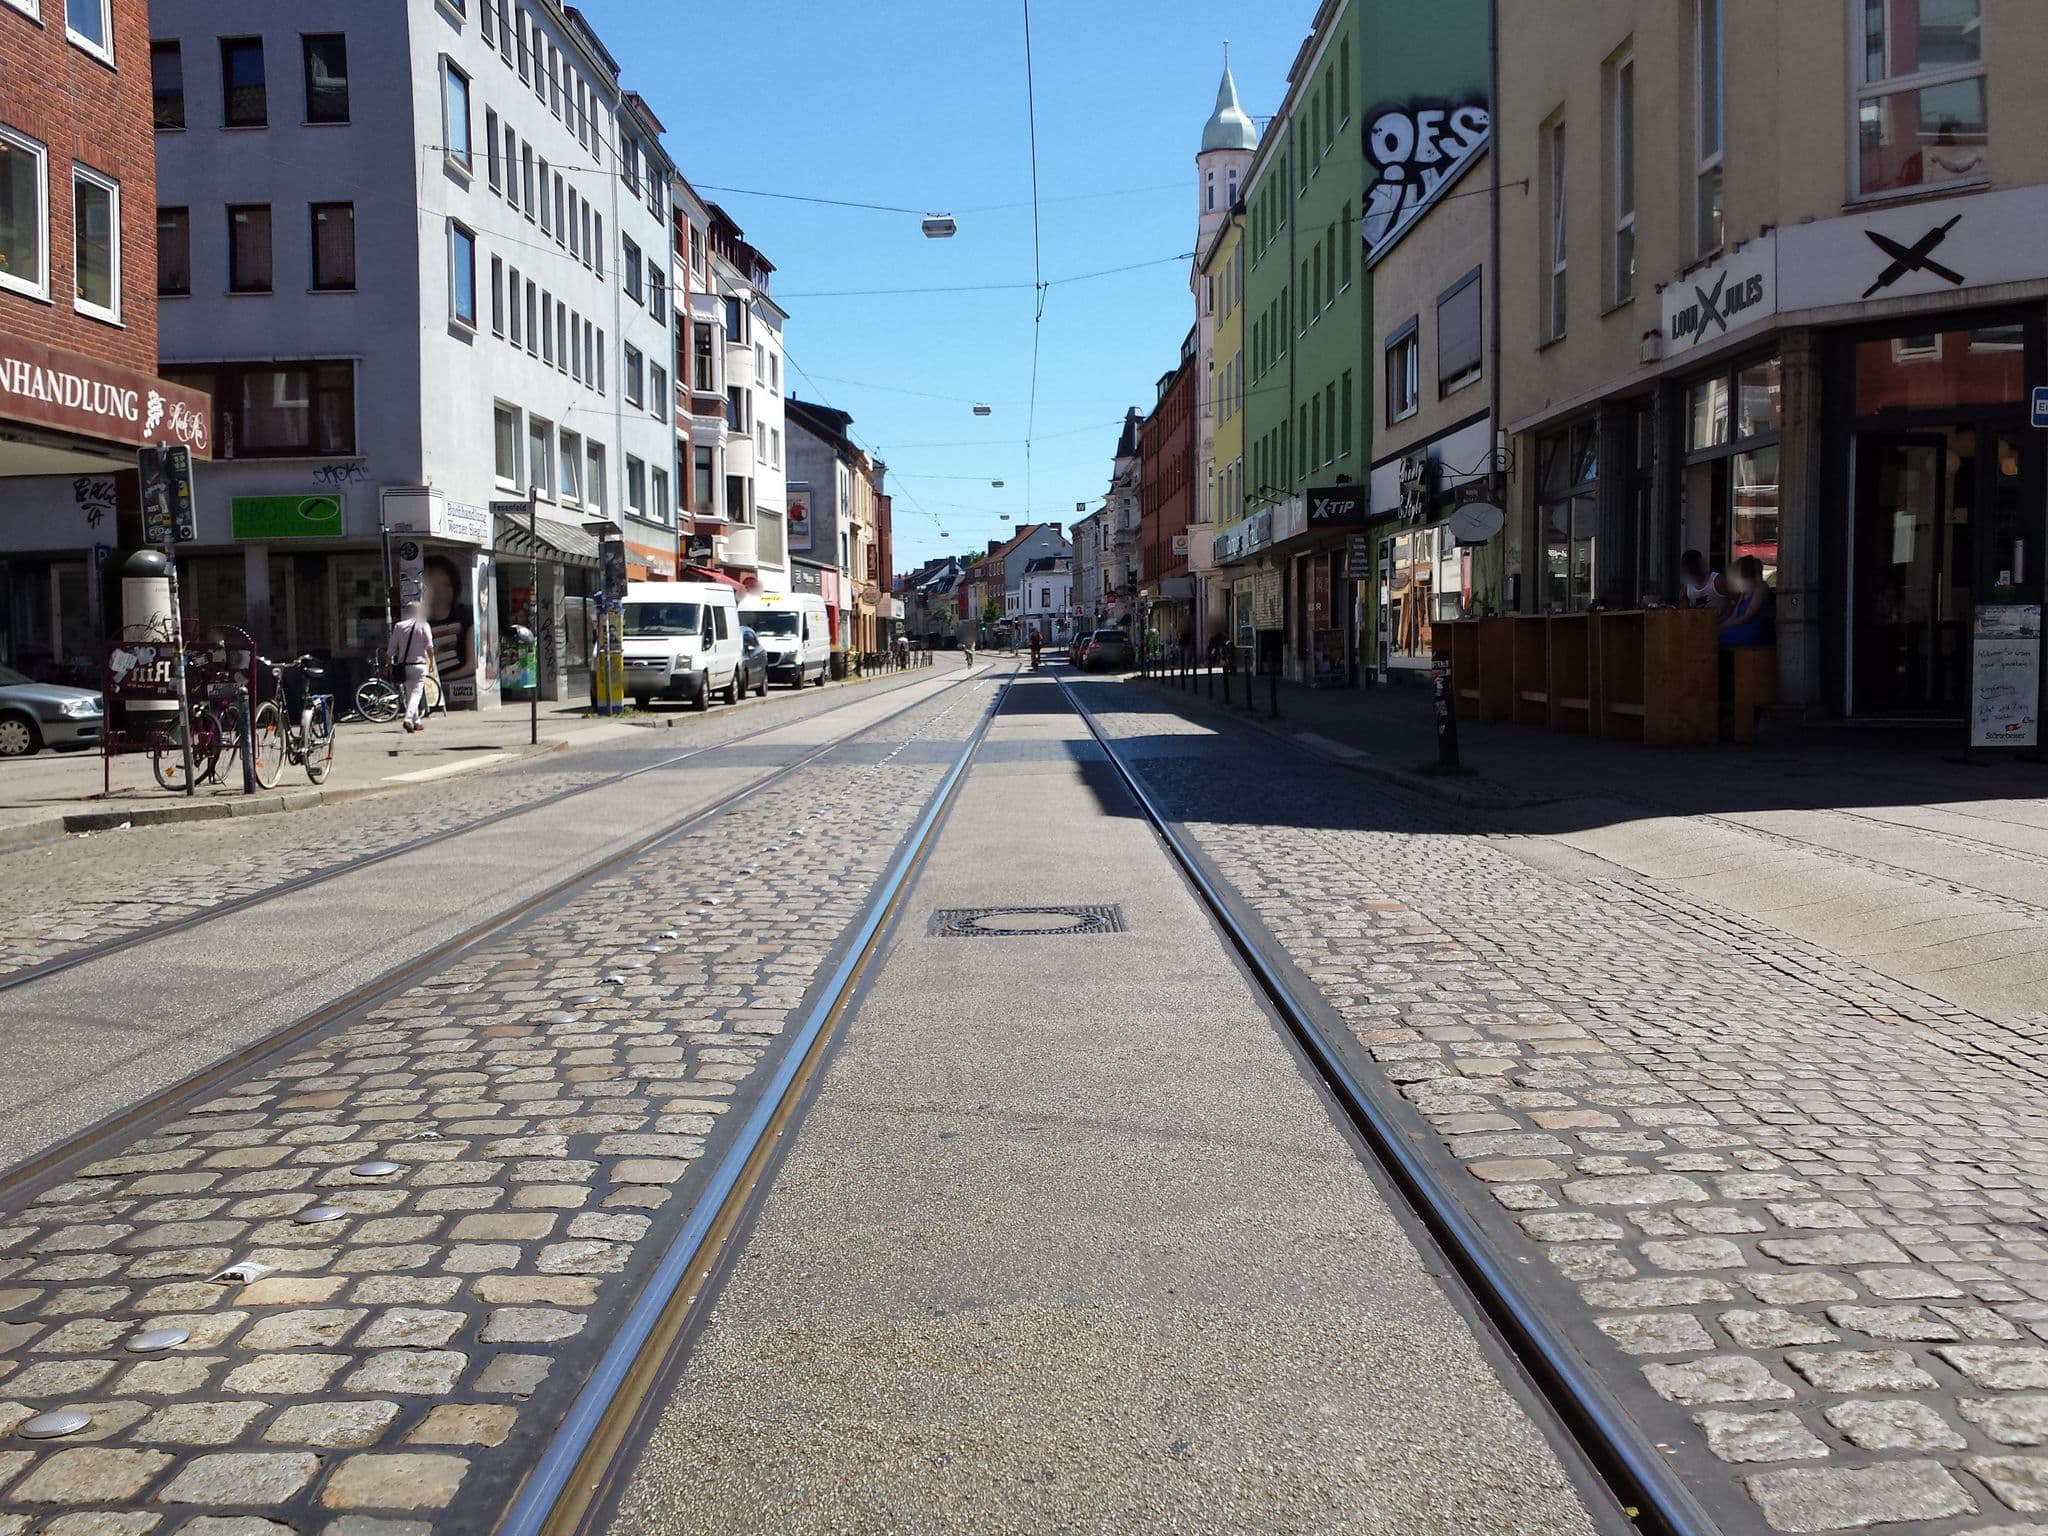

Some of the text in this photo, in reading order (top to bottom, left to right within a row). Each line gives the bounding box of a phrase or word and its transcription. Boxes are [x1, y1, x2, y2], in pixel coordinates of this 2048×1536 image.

[1720, 273, 1764, 318] JULES
[0, 357, 139, 422] NHANDLUNG
[447, 502, 487, 527] Buchhandlung
